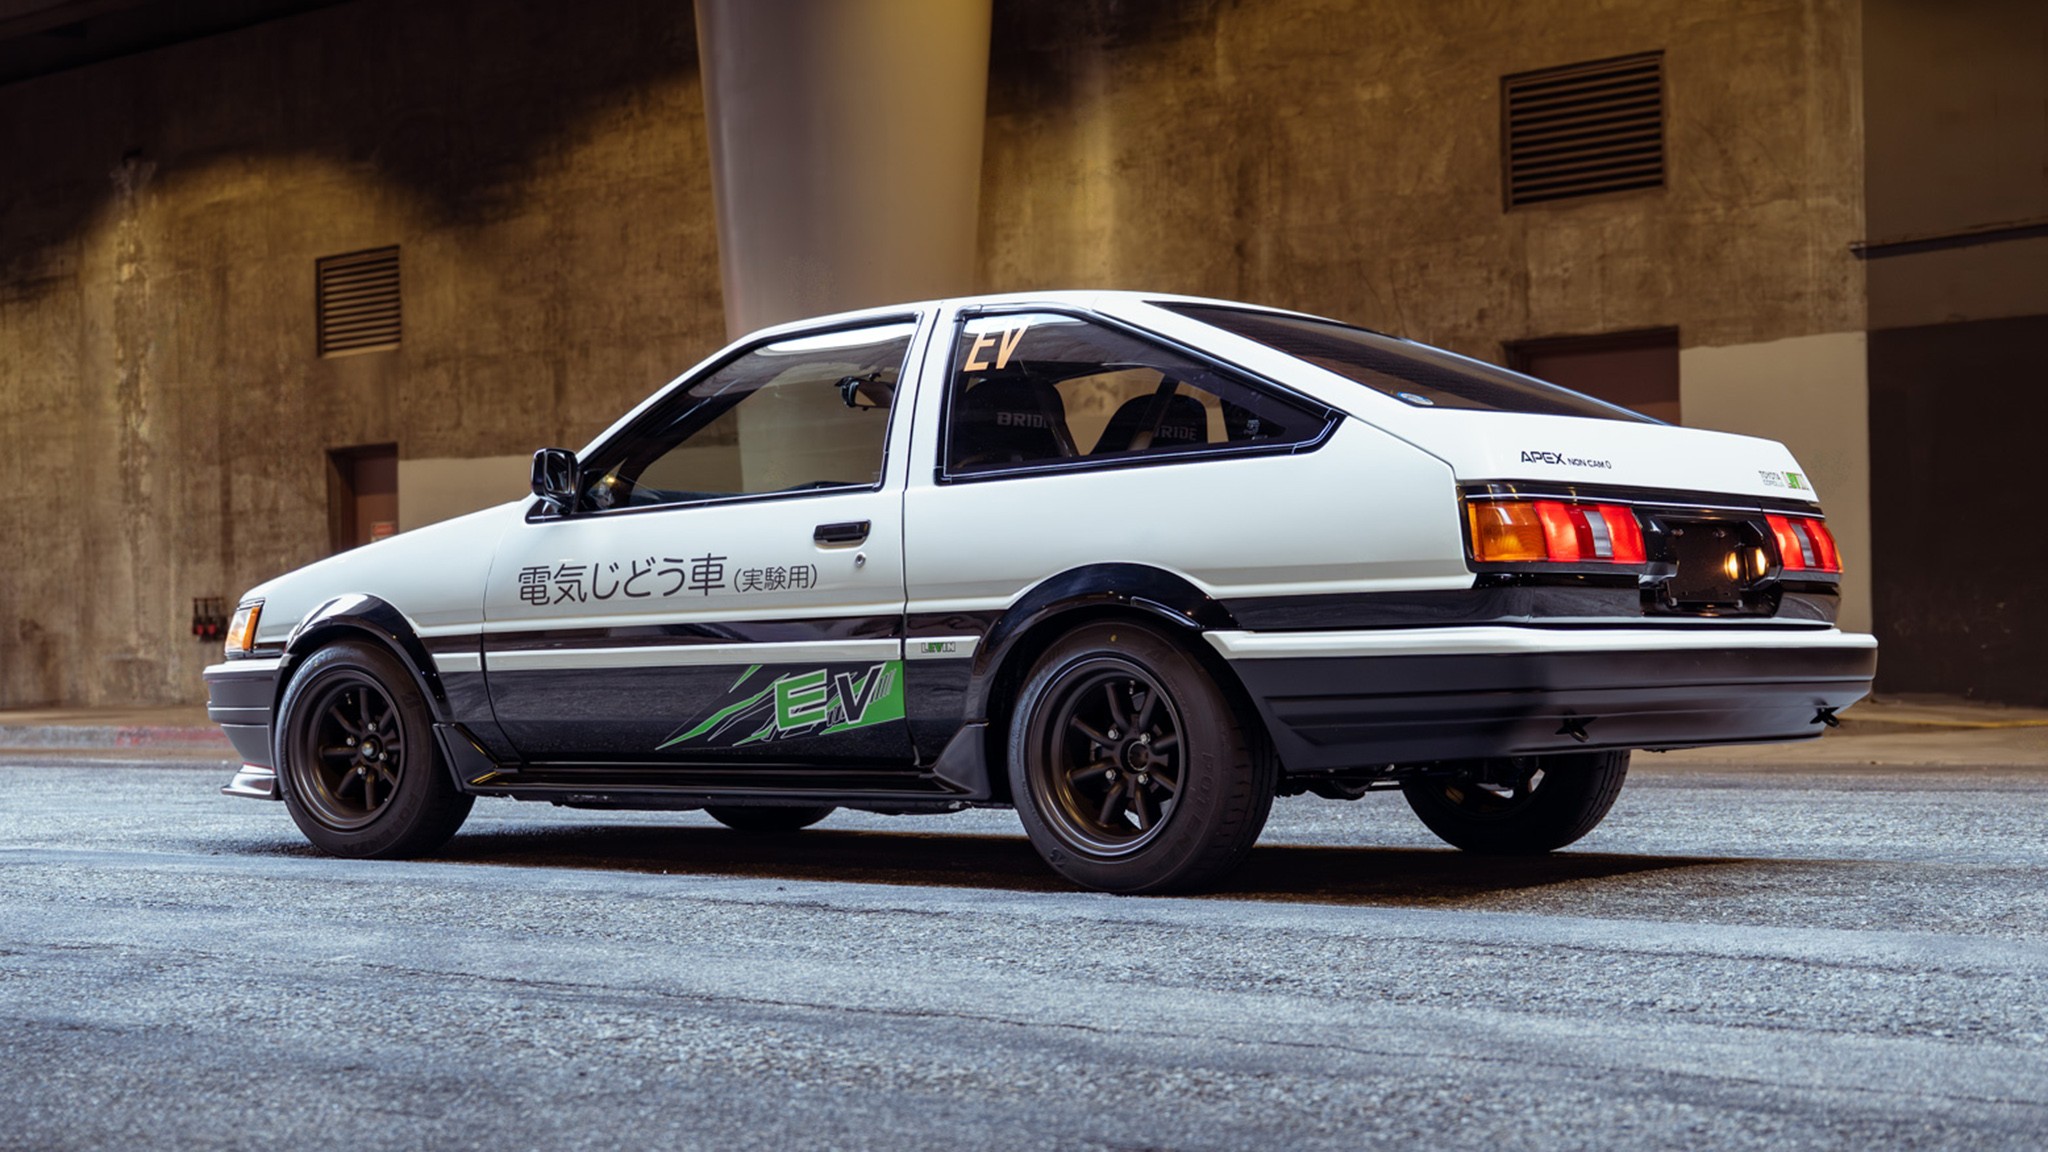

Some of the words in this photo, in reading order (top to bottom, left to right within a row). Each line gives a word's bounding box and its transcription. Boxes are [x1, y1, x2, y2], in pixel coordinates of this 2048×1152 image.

[963, 317, 1033, 372] EV
[1521, 450, 1566, 465] APEX
[1567, 458, 1586, 467] NON
[1588, 459, 1604, 469] CAM
[921, 641, 956, 653] LEVIN
[774, 661, 888, 732] EV
